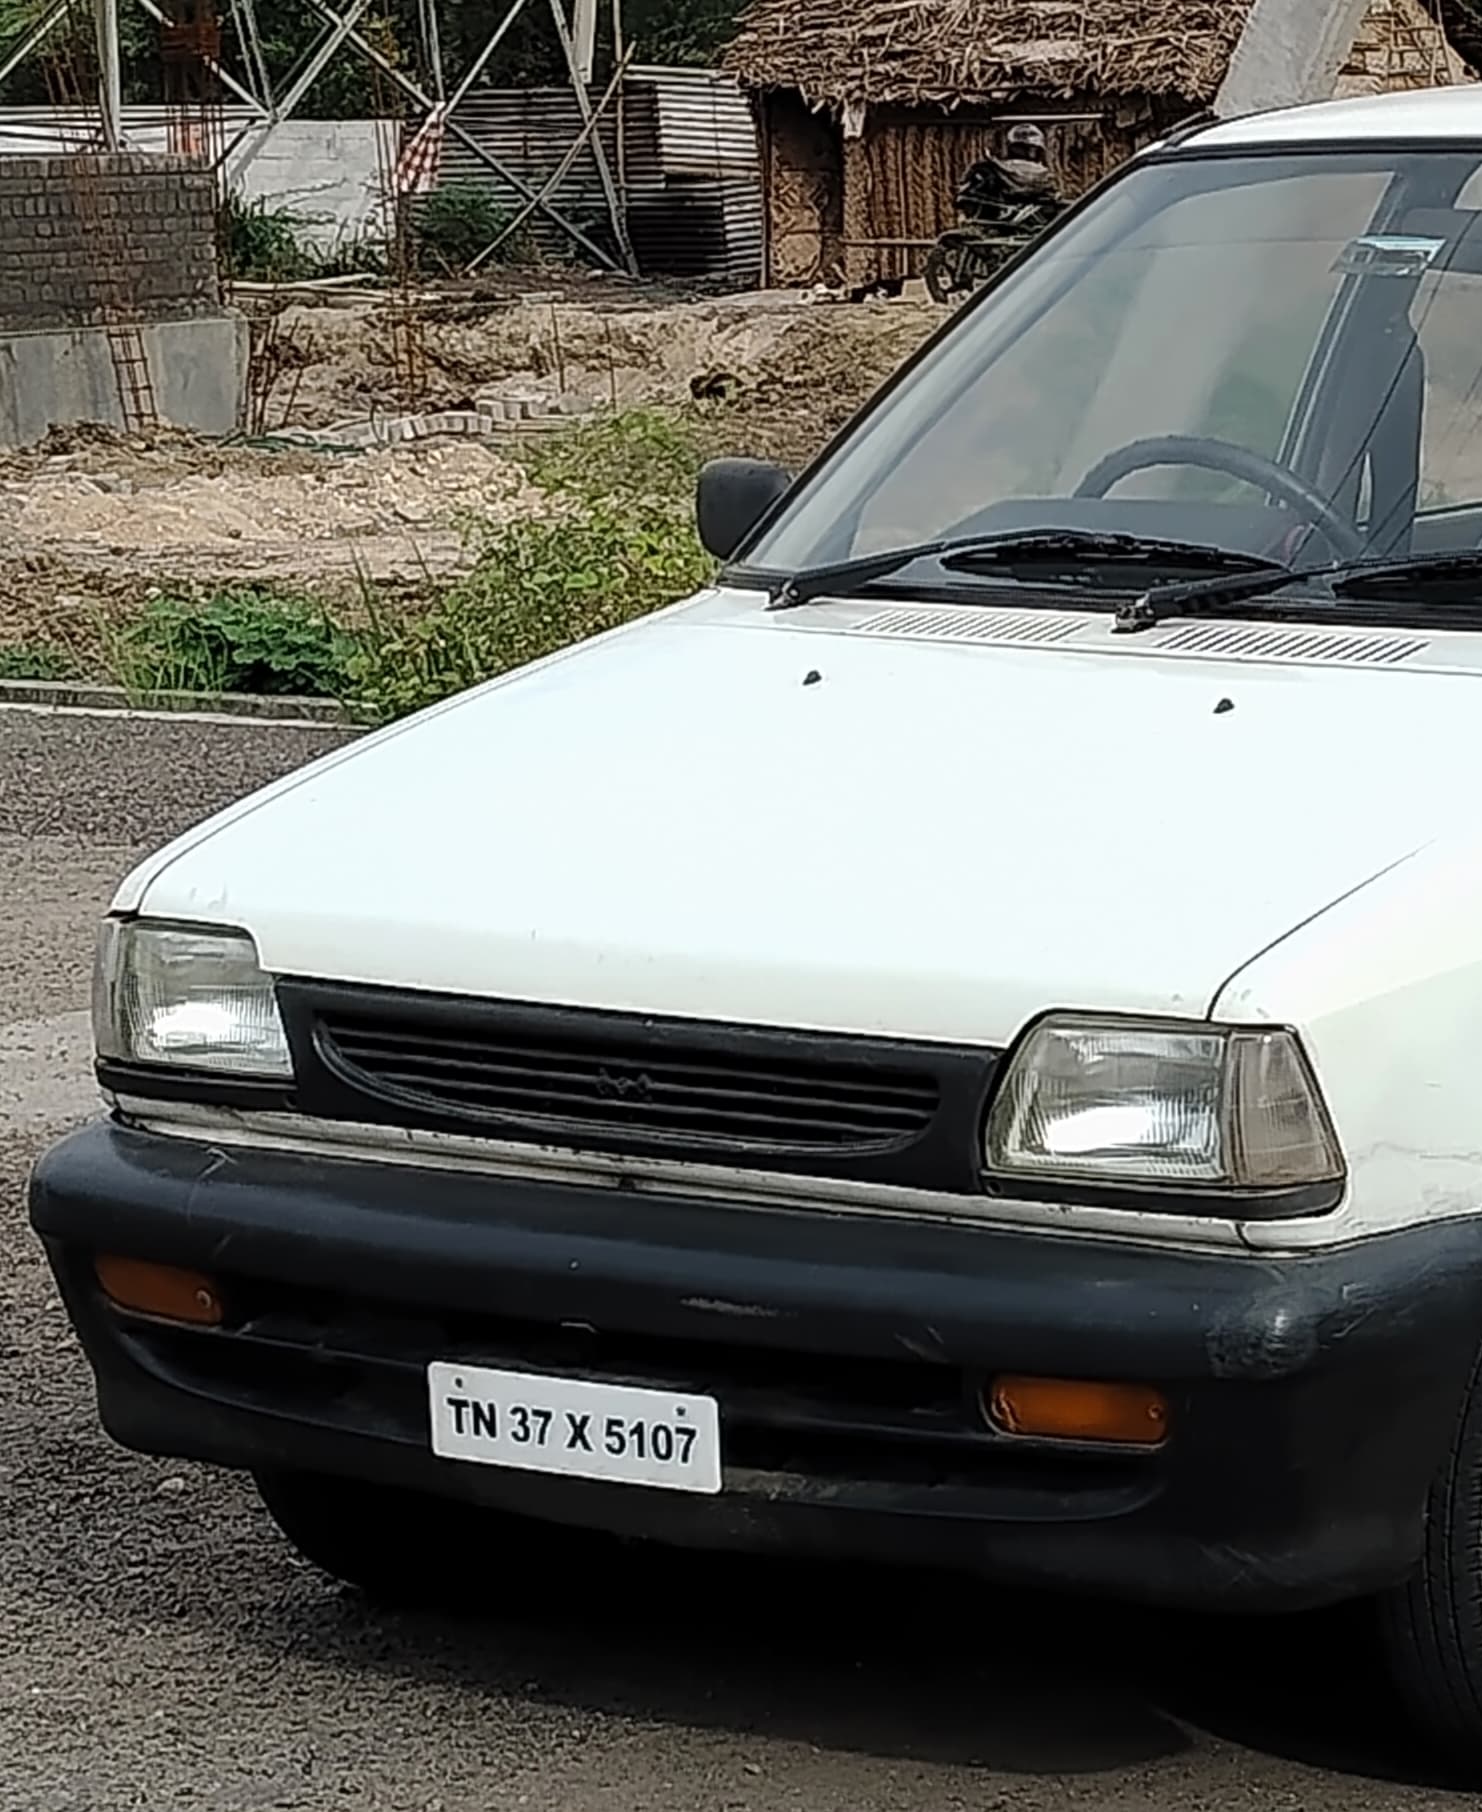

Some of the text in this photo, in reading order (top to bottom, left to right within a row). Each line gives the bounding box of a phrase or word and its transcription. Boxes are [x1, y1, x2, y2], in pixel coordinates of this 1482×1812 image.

[446, 1397, 697, 1464] TN 37 X 5107
